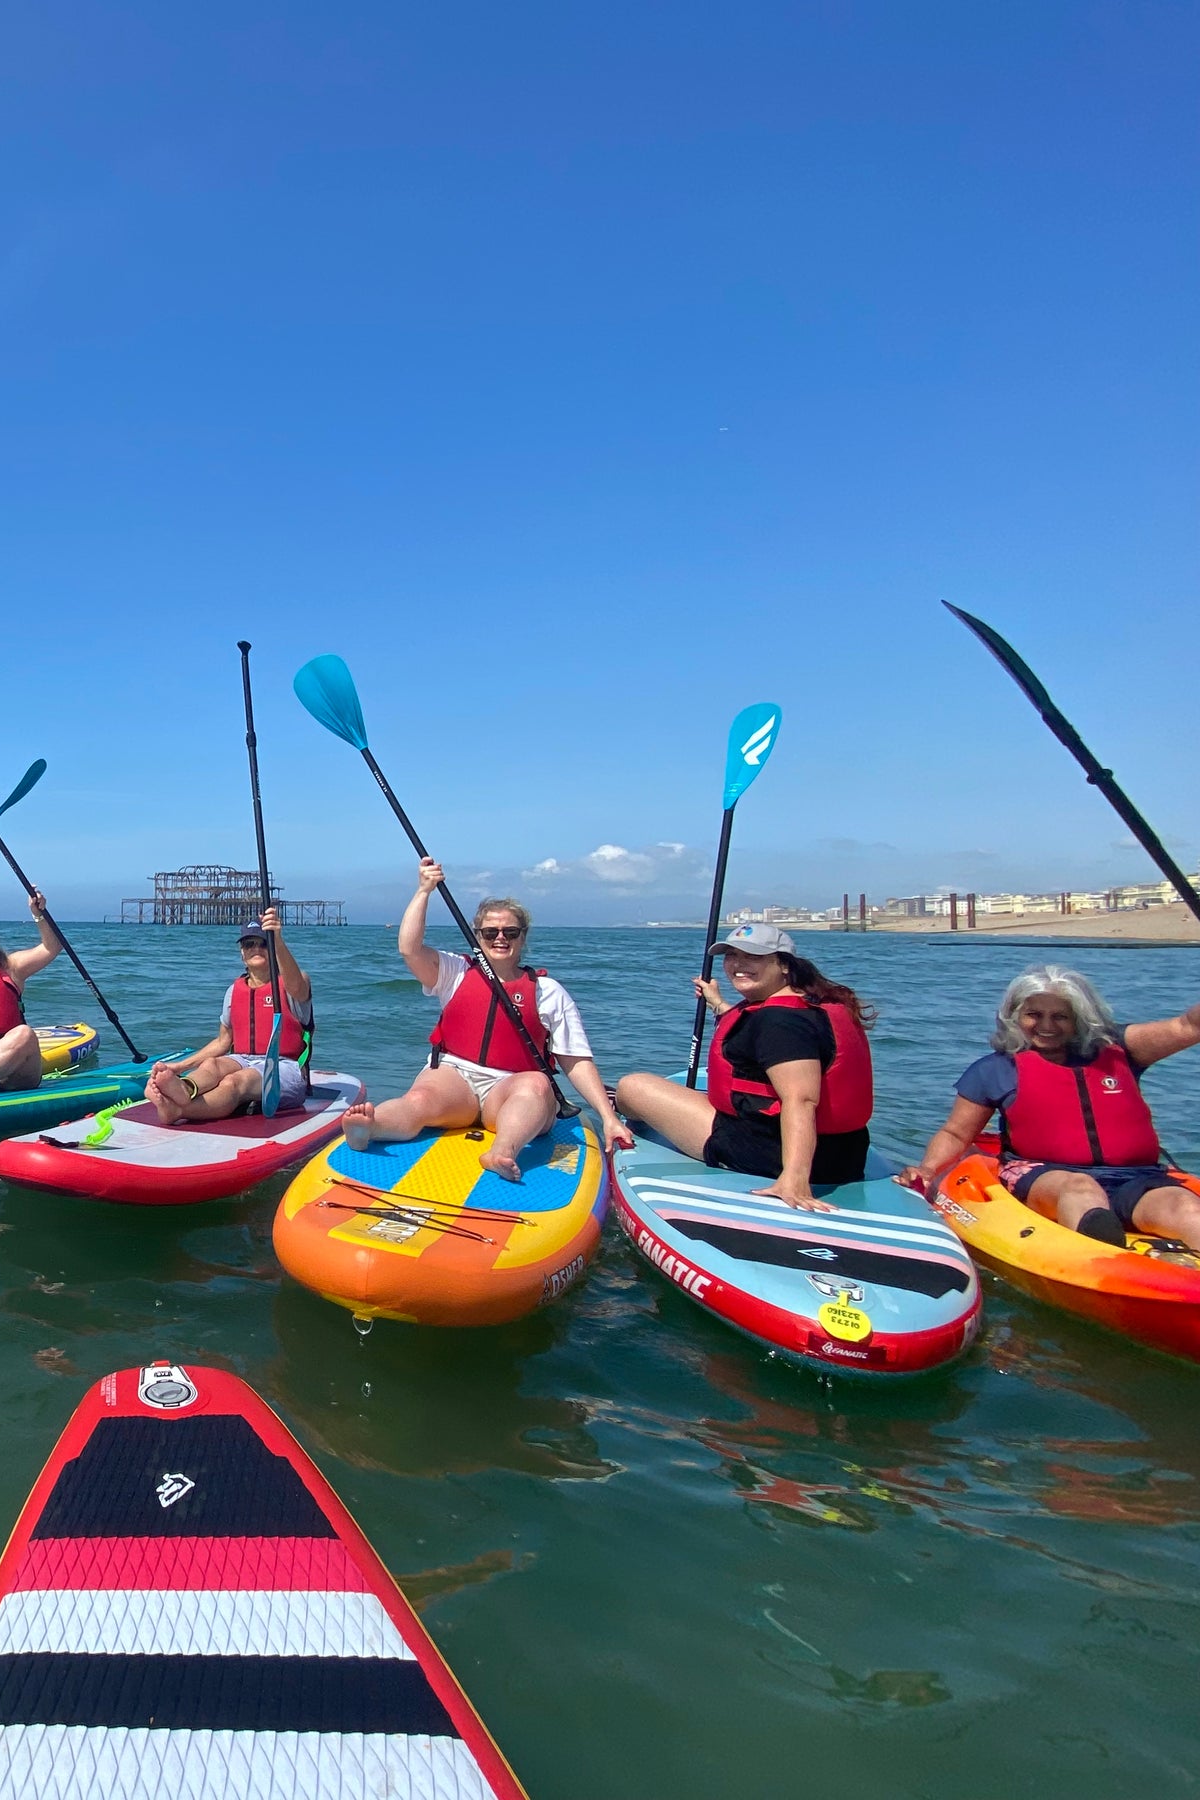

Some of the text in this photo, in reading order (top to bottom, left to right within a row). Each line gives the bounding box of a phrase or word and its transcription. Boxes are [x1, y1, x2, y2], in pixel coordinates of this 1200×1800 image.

[477, 953, 495, 980] FANATIC
[687, 1042, 697, 1069] FANATIC
[637, 1229, 713, 1300] FANATIC
[830, 1315, 861, 1330] 01273
[832, 1347, 869, 1360] FANATIC
